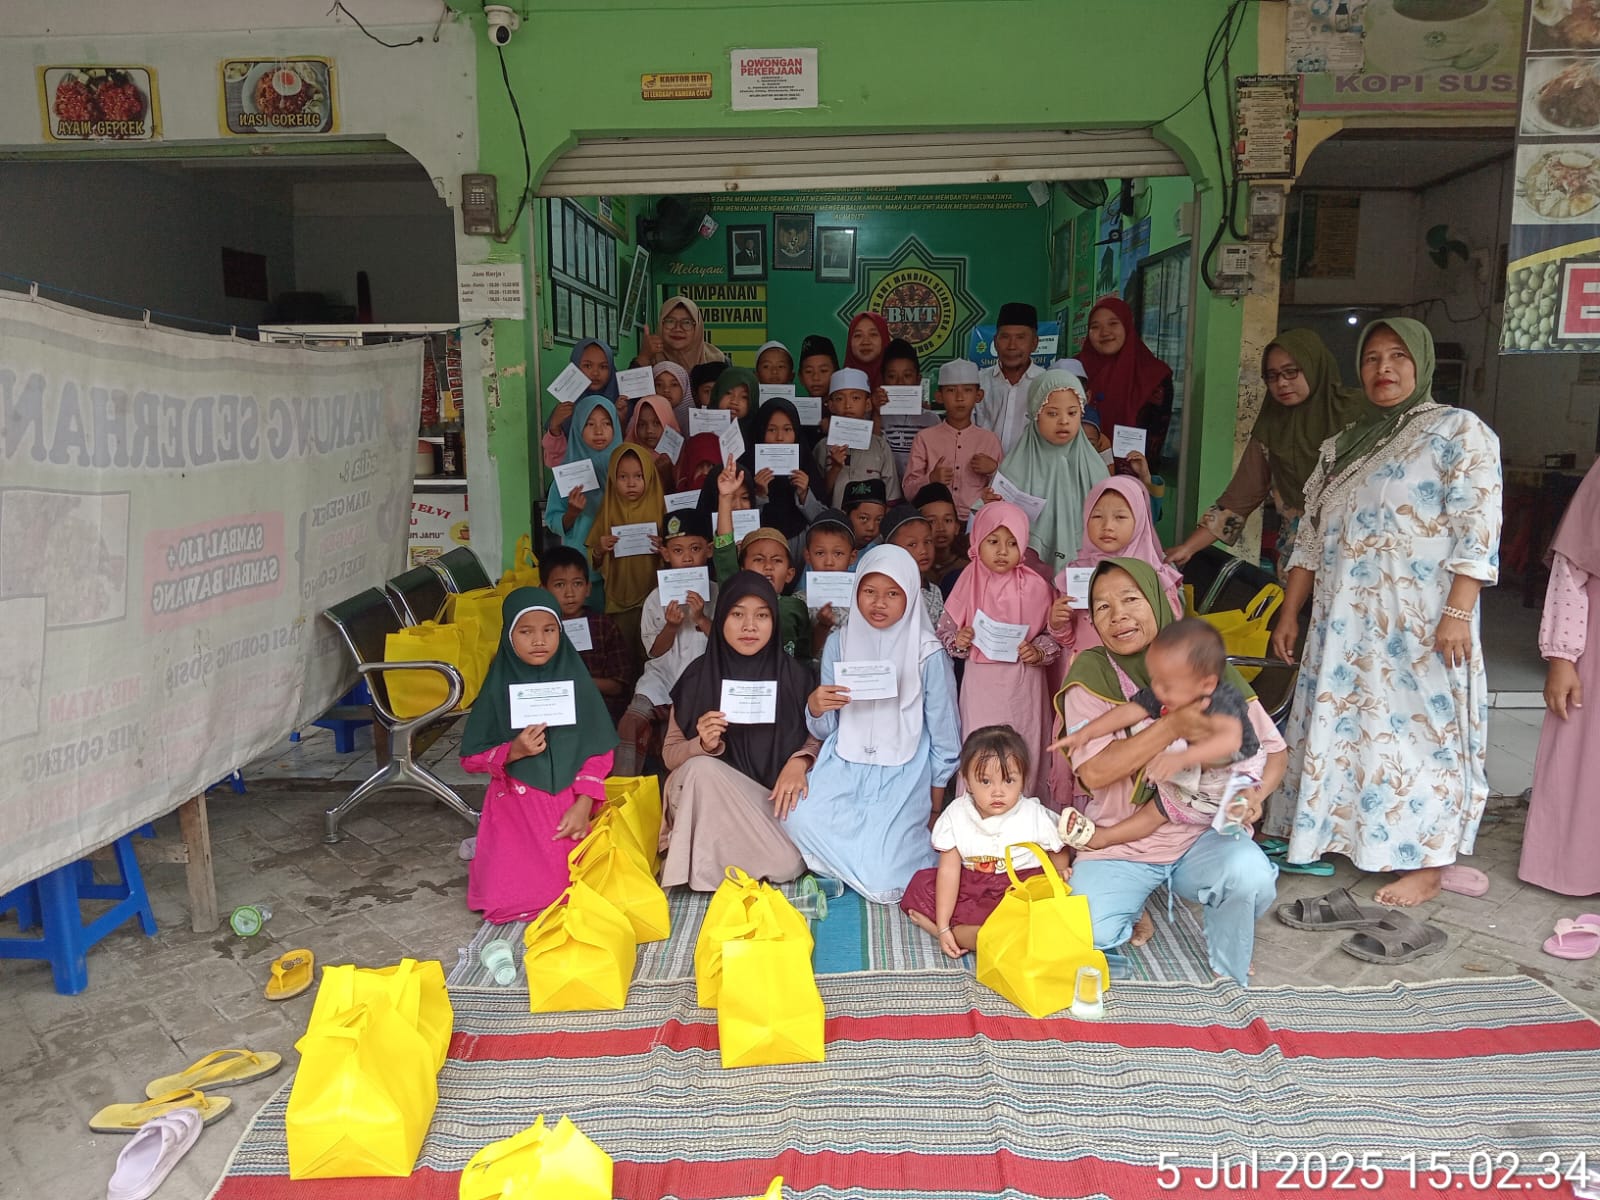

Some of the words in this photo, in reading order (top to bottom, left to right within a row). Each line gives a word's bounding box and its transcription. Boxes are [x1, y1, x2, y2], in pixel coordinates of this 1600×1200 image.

[740, 58, 803, 68] LOWONGAN
[740, 67, 803, 77] PEKERJAAN
[1335, 75, 1424, 93] KOPI
[1439, 74, 1517, 93] SUS
[238, 113, 268, 127] NASI
[271, 112, 321, 127] GORENG
[57, 120, 92, 136] AYAM
[97, 120, 145, 136] GEPREK
[669, 262, 725, 277] Melayani
[680, 286, 757, 301] SIMPANAN
[698, 308, 763, 322] MBIYAAN
[886, 306, 938, 323] BMT
[418, 504, 451, 519] ELVI
